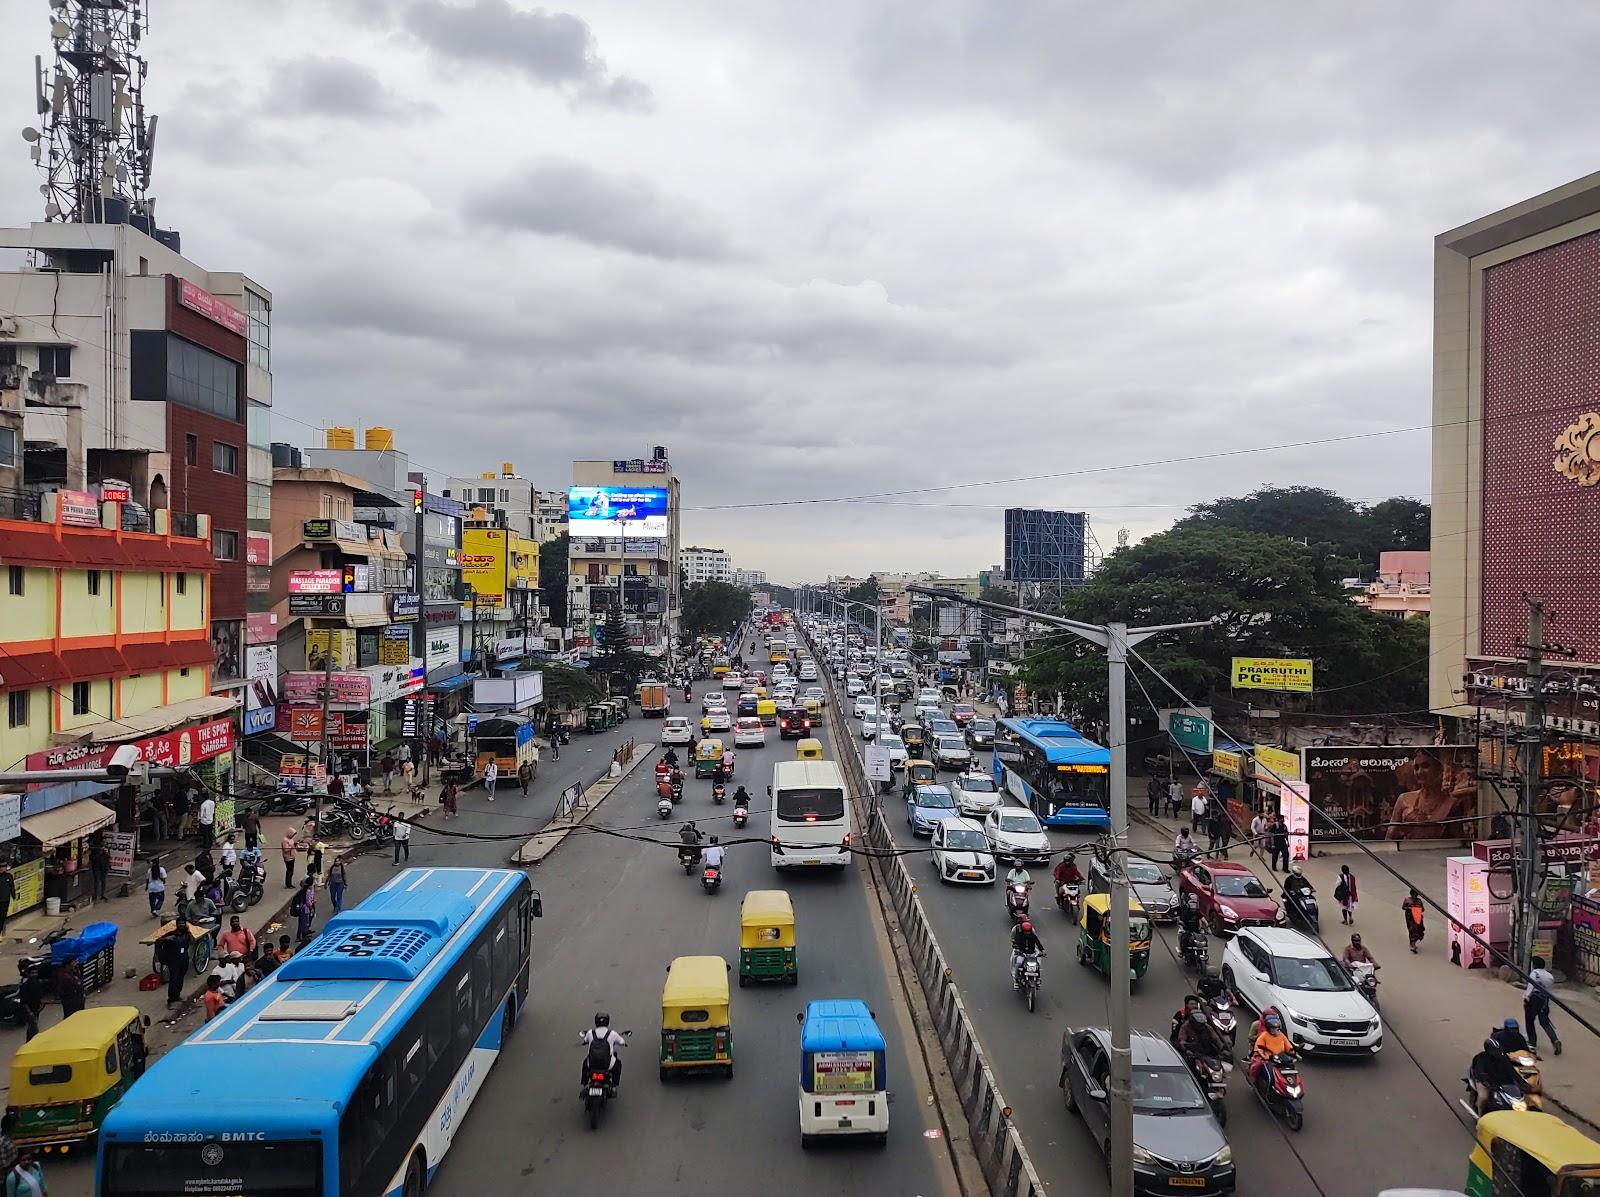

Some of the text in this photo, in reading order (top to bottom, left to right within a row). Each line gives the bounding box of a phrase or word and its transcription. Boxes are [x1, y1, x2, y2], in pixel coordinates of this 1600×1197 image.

[104, 491, 126, 500] LODGE
[414, 490, 423, 514] SPA
[315, 577, 340, 585] PARADISE
[256, 661, 269, 672] ZEISS
[1240, 666, 1307, 675] PRAKRUTHI
[1238, 673, 1262, 683] PG
[337, 682, 368, 690] RESIDENCY
[197, 721, 230, 742] THE SPICY
[201, 737, 228, 755] SAMBAR
[86, 758, 101, 769] LODGE
[1311, 756, 1409, 770] ಜೋಸ್ ಆಲುಕ್ಕಾಸ್
[1312, 828, 1324, 836] JOS
[221, 1131, 265, 1142] BMTC
